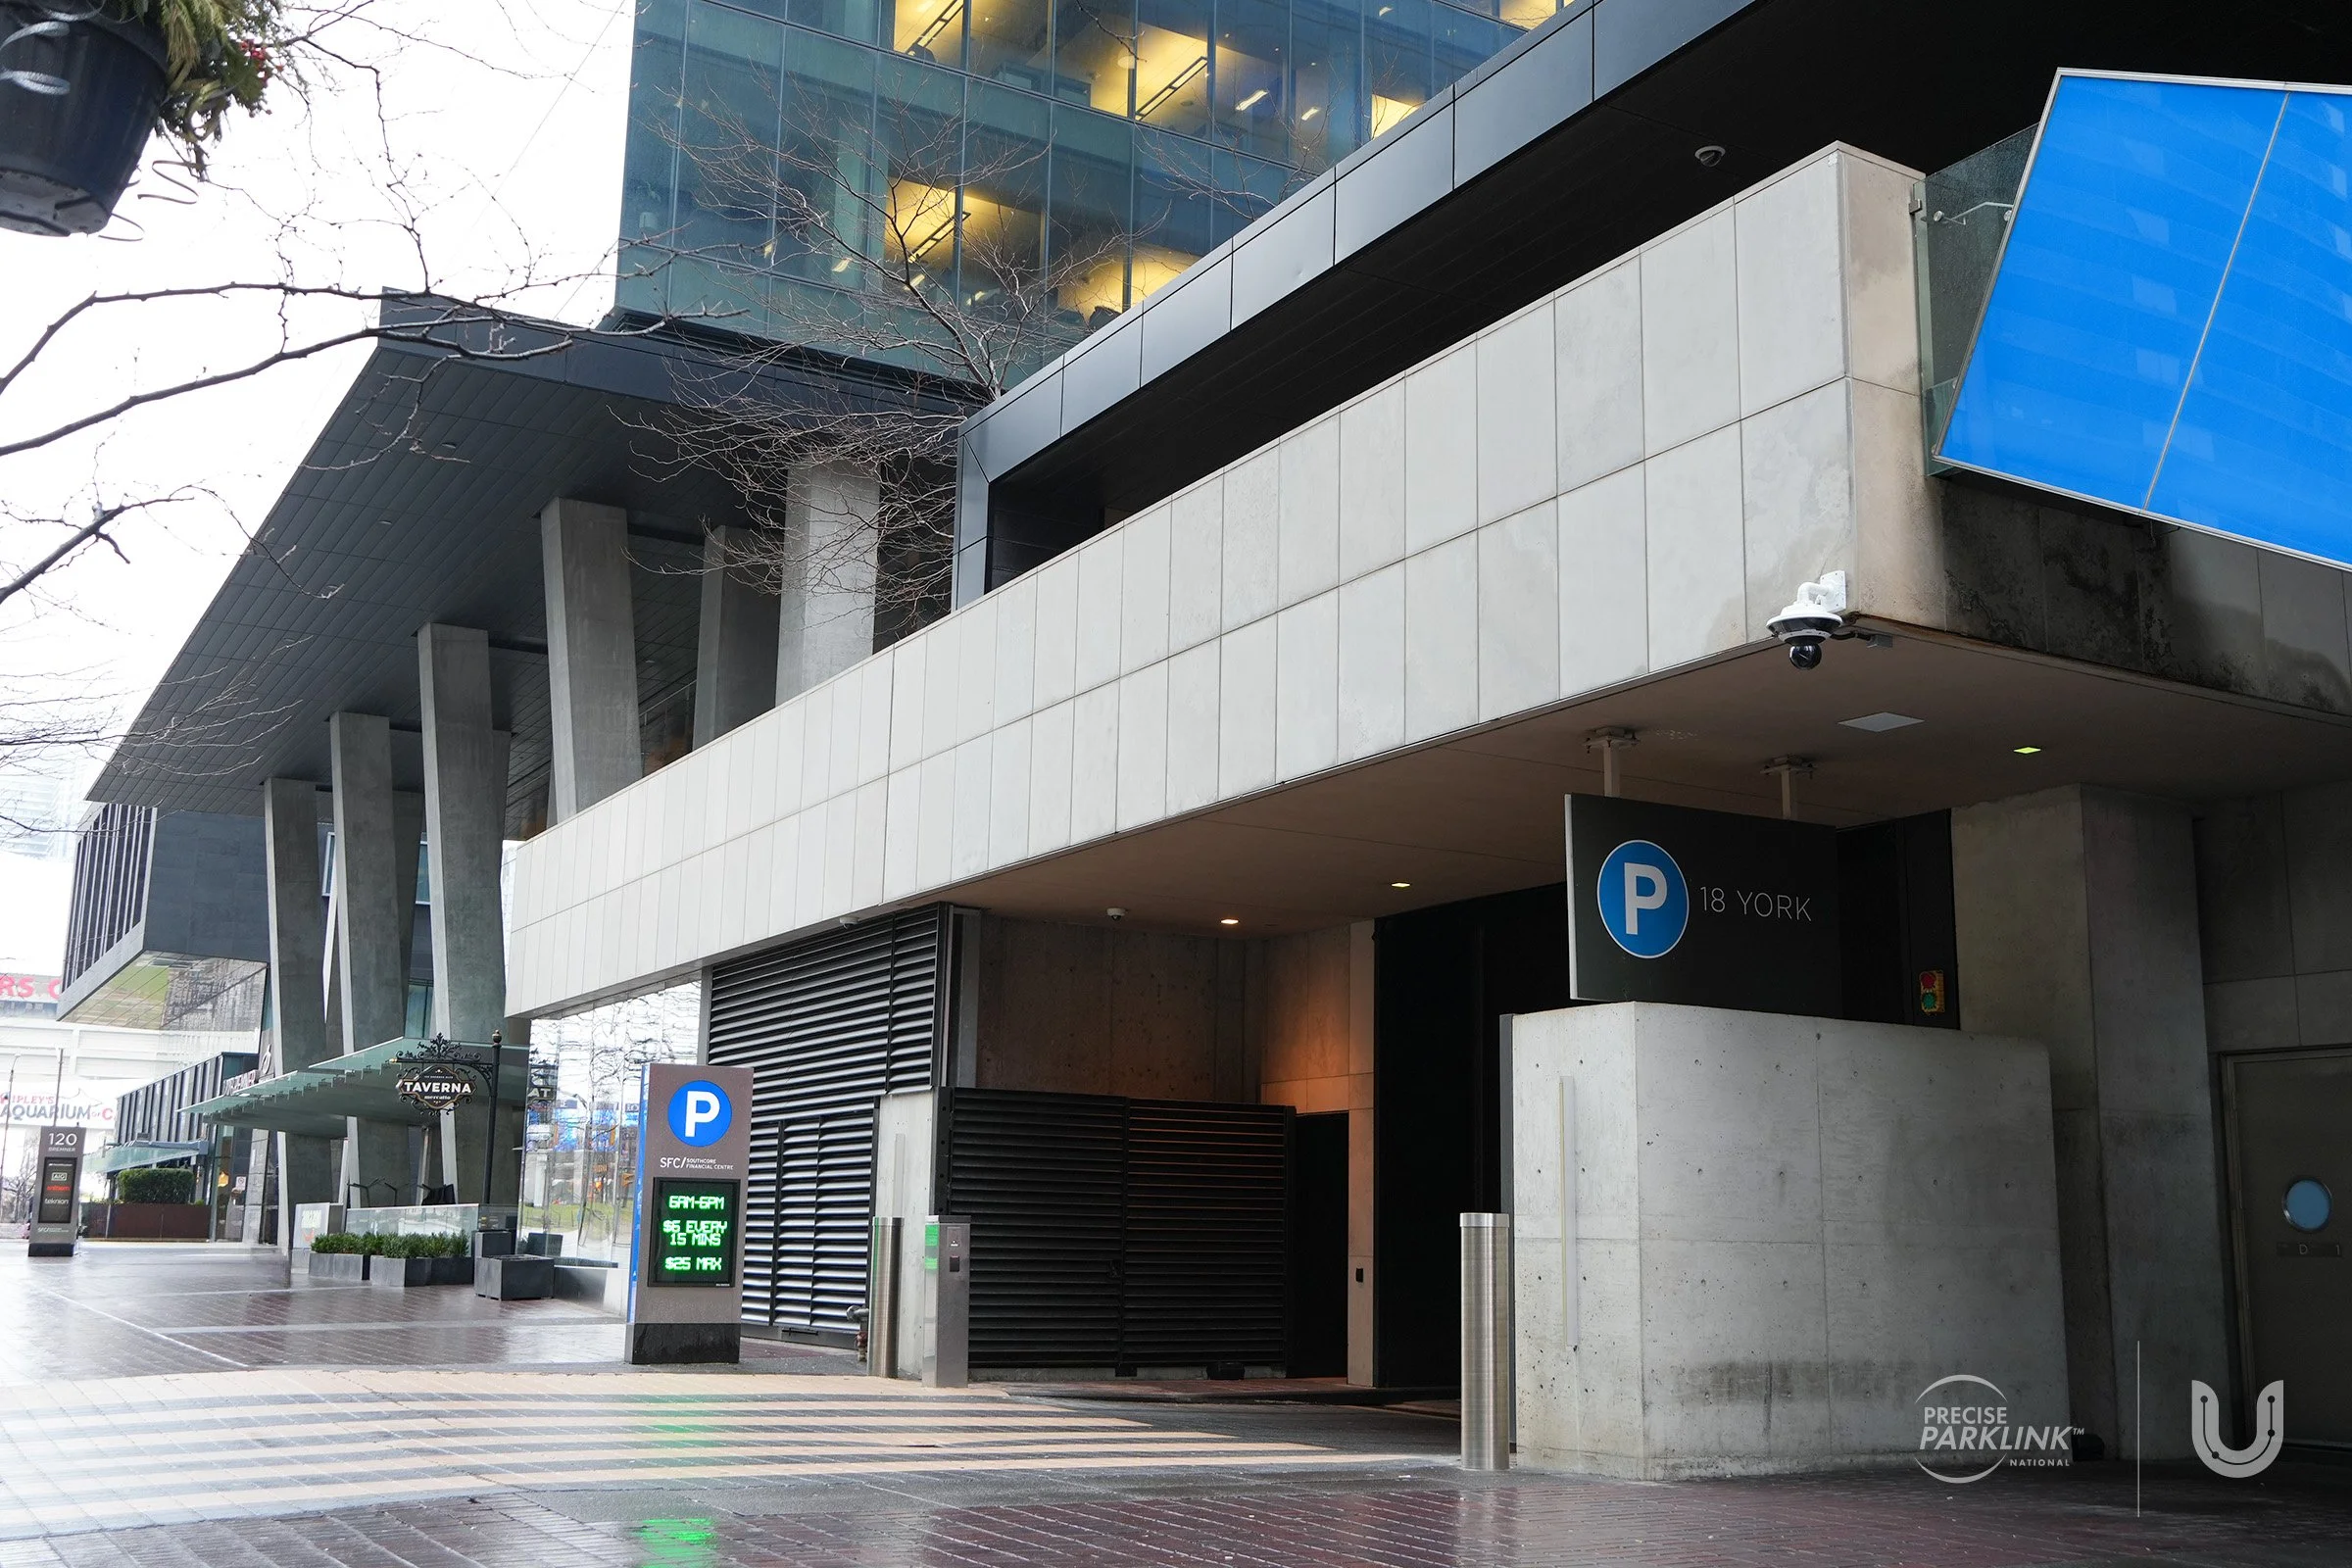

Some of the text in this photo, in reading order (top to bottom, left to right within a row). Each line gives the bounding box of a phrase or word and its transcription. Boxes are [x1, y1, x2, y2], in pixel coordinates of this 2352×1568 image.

[1624, 862, 1668, 936] P
[1700, 886, 1812, 922] 18 YORK
[404, 1081, 471, 1094] TAVERNA
[684, 1090, 720, 1138] P
[48, 1133, 77, 1147] 120
[668, 1195, 725, 1210] 6AM-6PM
[686, 1220, 728, 1235] EVERY
[669, 1232, 721, 1248] 15 MINS
[664, 1256, 722, 1271] $25 MAX
